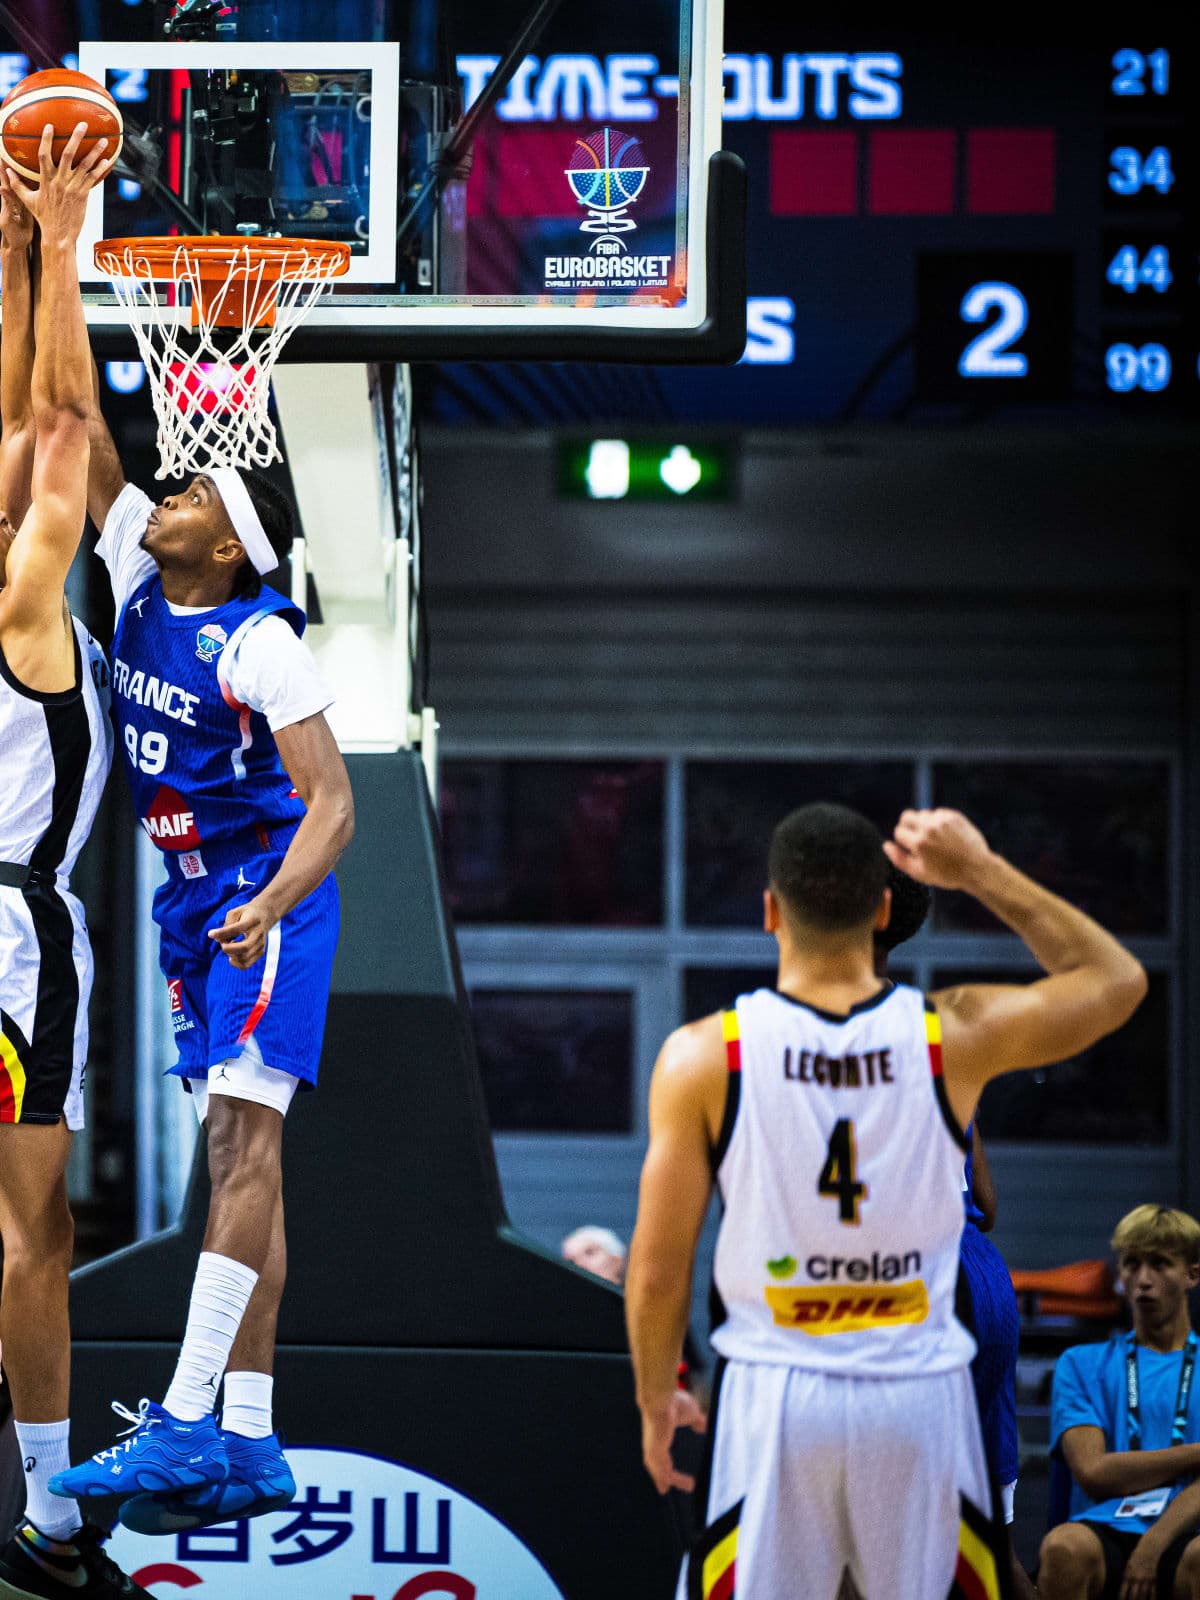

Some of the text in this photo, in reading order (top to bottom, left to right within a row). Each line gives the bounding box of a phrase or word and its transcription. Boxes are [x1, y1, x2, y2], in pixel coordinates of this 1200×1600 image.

[1110, 48, 1170, 96] 21
[1107, 146, 1175, 194] 34
[544, 255, 671, 279] EUROBASKET
[596, 243, 620, 255] FIBA
[1106, 244, 1172, 293] 44
[958, 281, 1029, 378] 2
[1105, 343, 1171, 392] 99
[113, 657, 201, 728] FRANCE
[124, 723, 169, 776] 99
[140, 811, 195, 839] MAIF
[818, 1117, 869, 1227] 4
[806, 1250, 922, 1282] crelan
[792, 1297, 906, 1323] DHL
